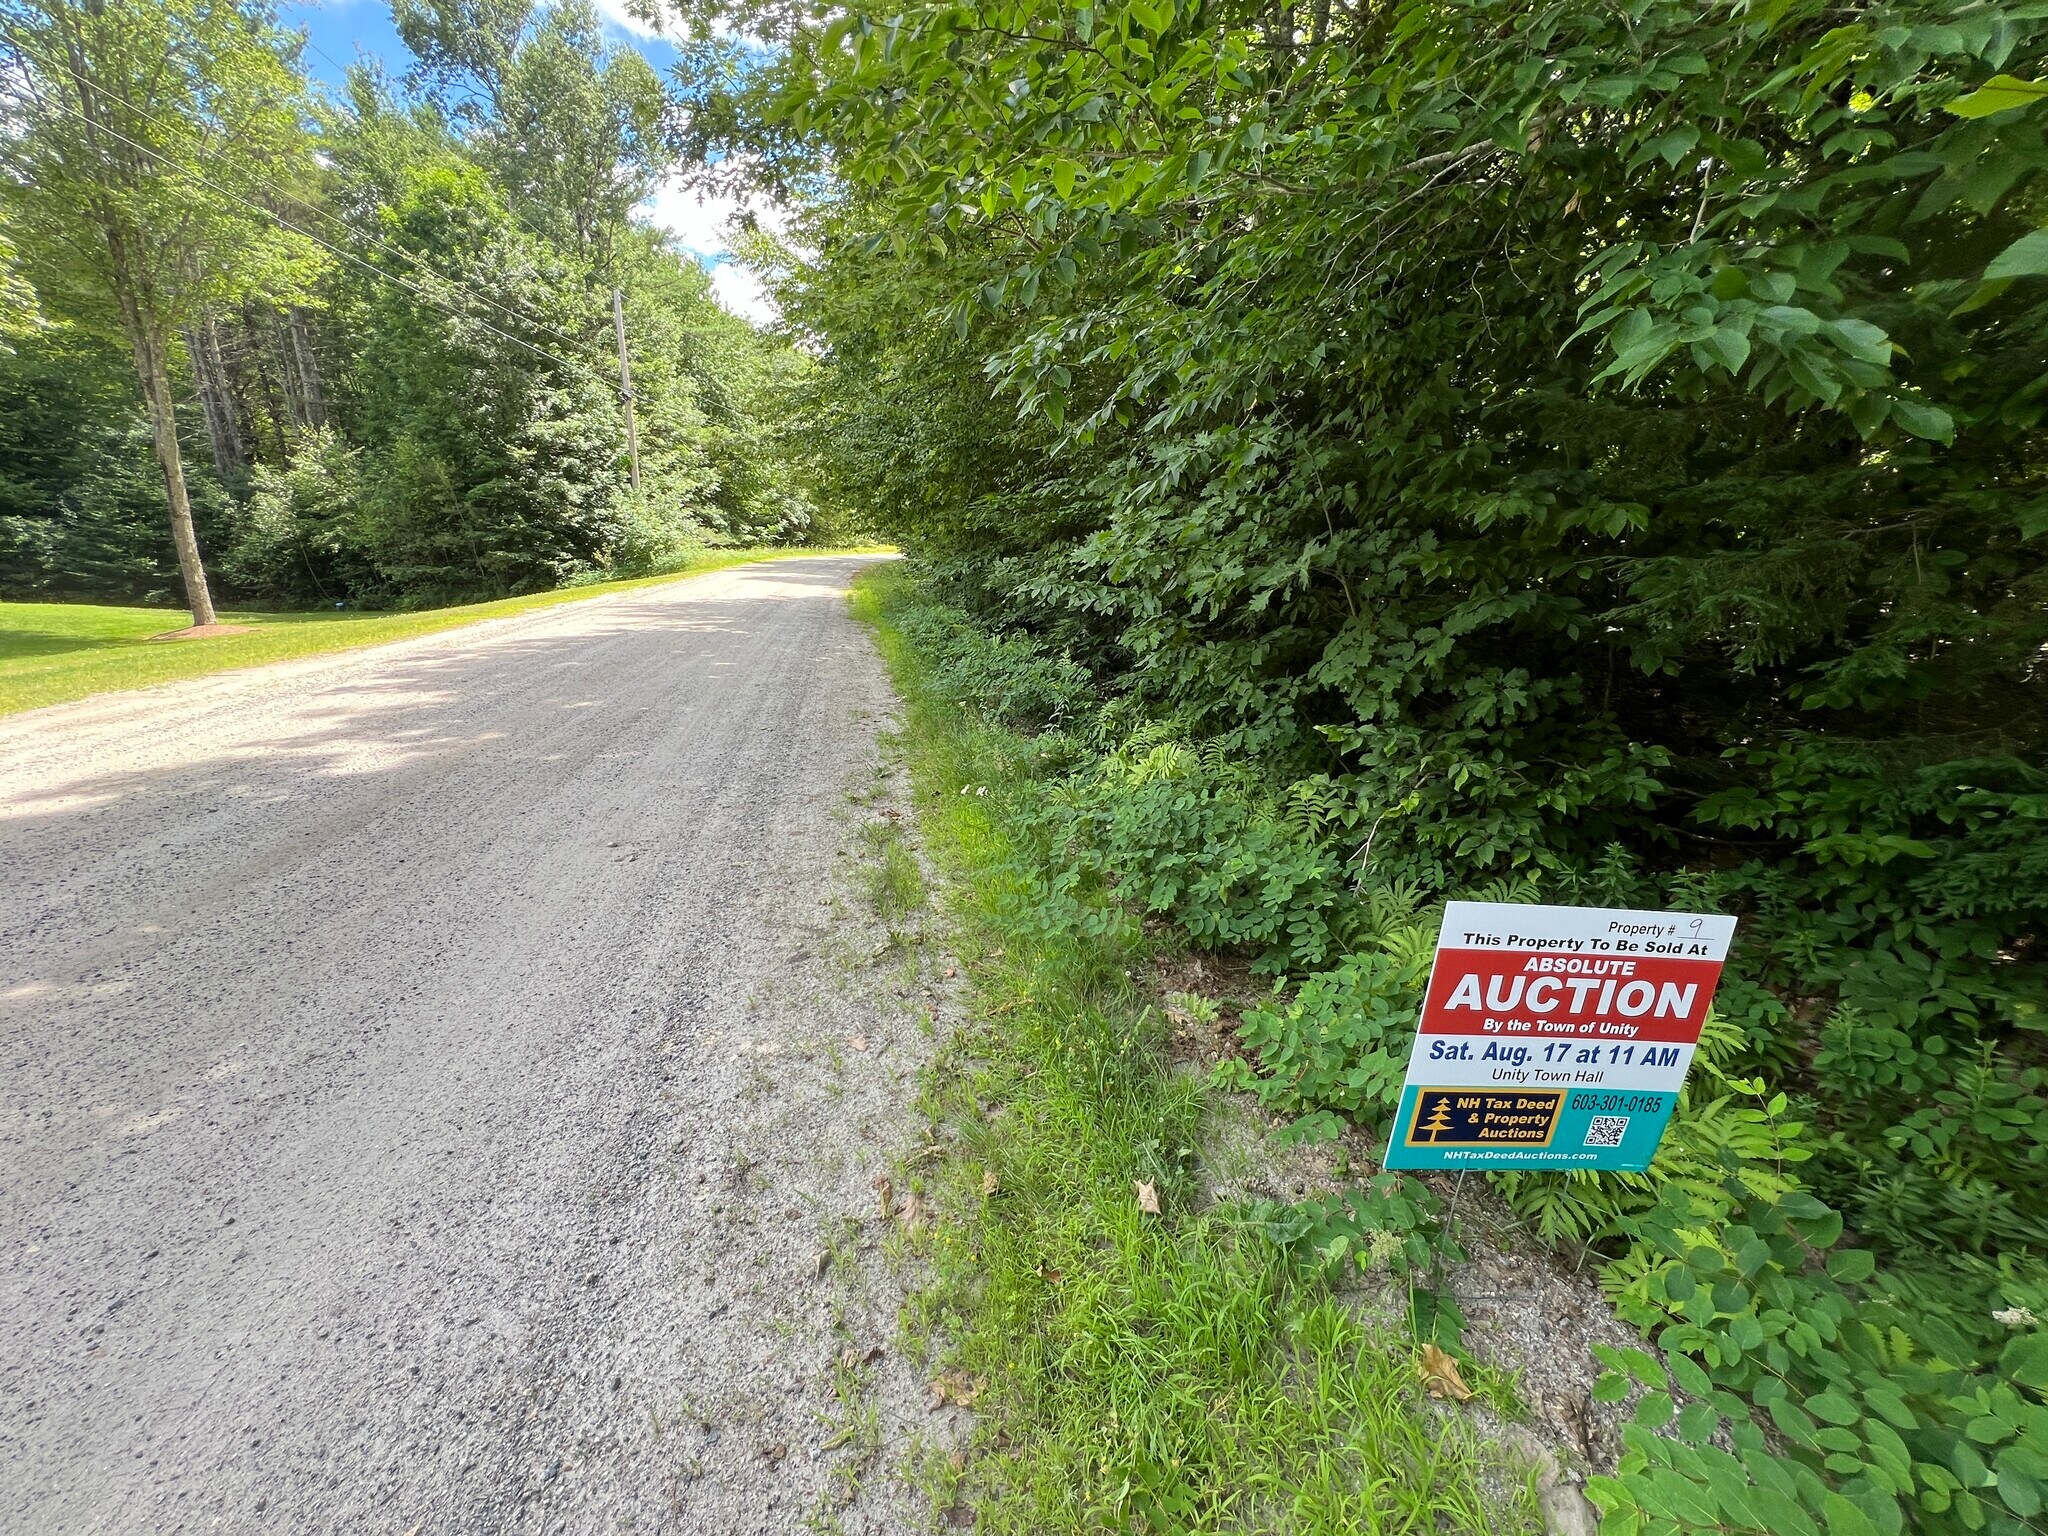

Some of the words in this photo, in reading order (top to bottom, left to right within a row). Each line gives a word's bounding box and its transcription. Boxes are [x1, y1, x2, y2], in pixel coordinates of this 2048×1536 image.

[1608, 921, 1664, 937] Property
[1668, 925, 1676, 934] #
[1463, 933, 1501, 946] This
[1507, 935, 1584, 951] Property
[1590, 939, 1610, 950] To
[1616, 941, 1639, 951] Be
[1644, 942, 1682, 954] Sold
[1687, 944, 1708, 955] At
[1524, 957, 1636, 976] ABSOLUTE
[1444, 974, 1698, 1019] AUCTION
[1483, 1019, 1503, 1032] By
[1507, 1020, 1530, 1031] the
[1536, 1020, 1575, 1033] Town
[1579, 1022, 1596, 1033] of
[1599, 1023, 1639, 1037] Unity
[1429, 1040, 1474, 1060] Sat.
[1482, 1041, 1533, 1066] Aug.
[1543, 1043, 1571, 1063] 17
[1576, 1046, 1599, 1064] at
[1609, 1046, 1636, 1065] 11
[1640, 1048, 1680, 1067] AM
[1492, 1068, 1529, 1083] Unity
[1533, 1070, 1571, 1082] Town
[1575, 1071, 1604, 1083] Hall
[1457, 1098, 1480, 1109] NH
[1485, 1098, 1511, 1109] Tax
[1516, 1098, 1555, 1110] Deed
[1572, 1093, 1663, 1113] 603-301-0185
[1468, 1114, 1479, 1123] &
[1483, 1114, 1549, 1126] Property
[1478, 1127, 1545, 1138] Auctions
[1444, 1151, 1598, 1160] NHTaxDeedAuctions.com
